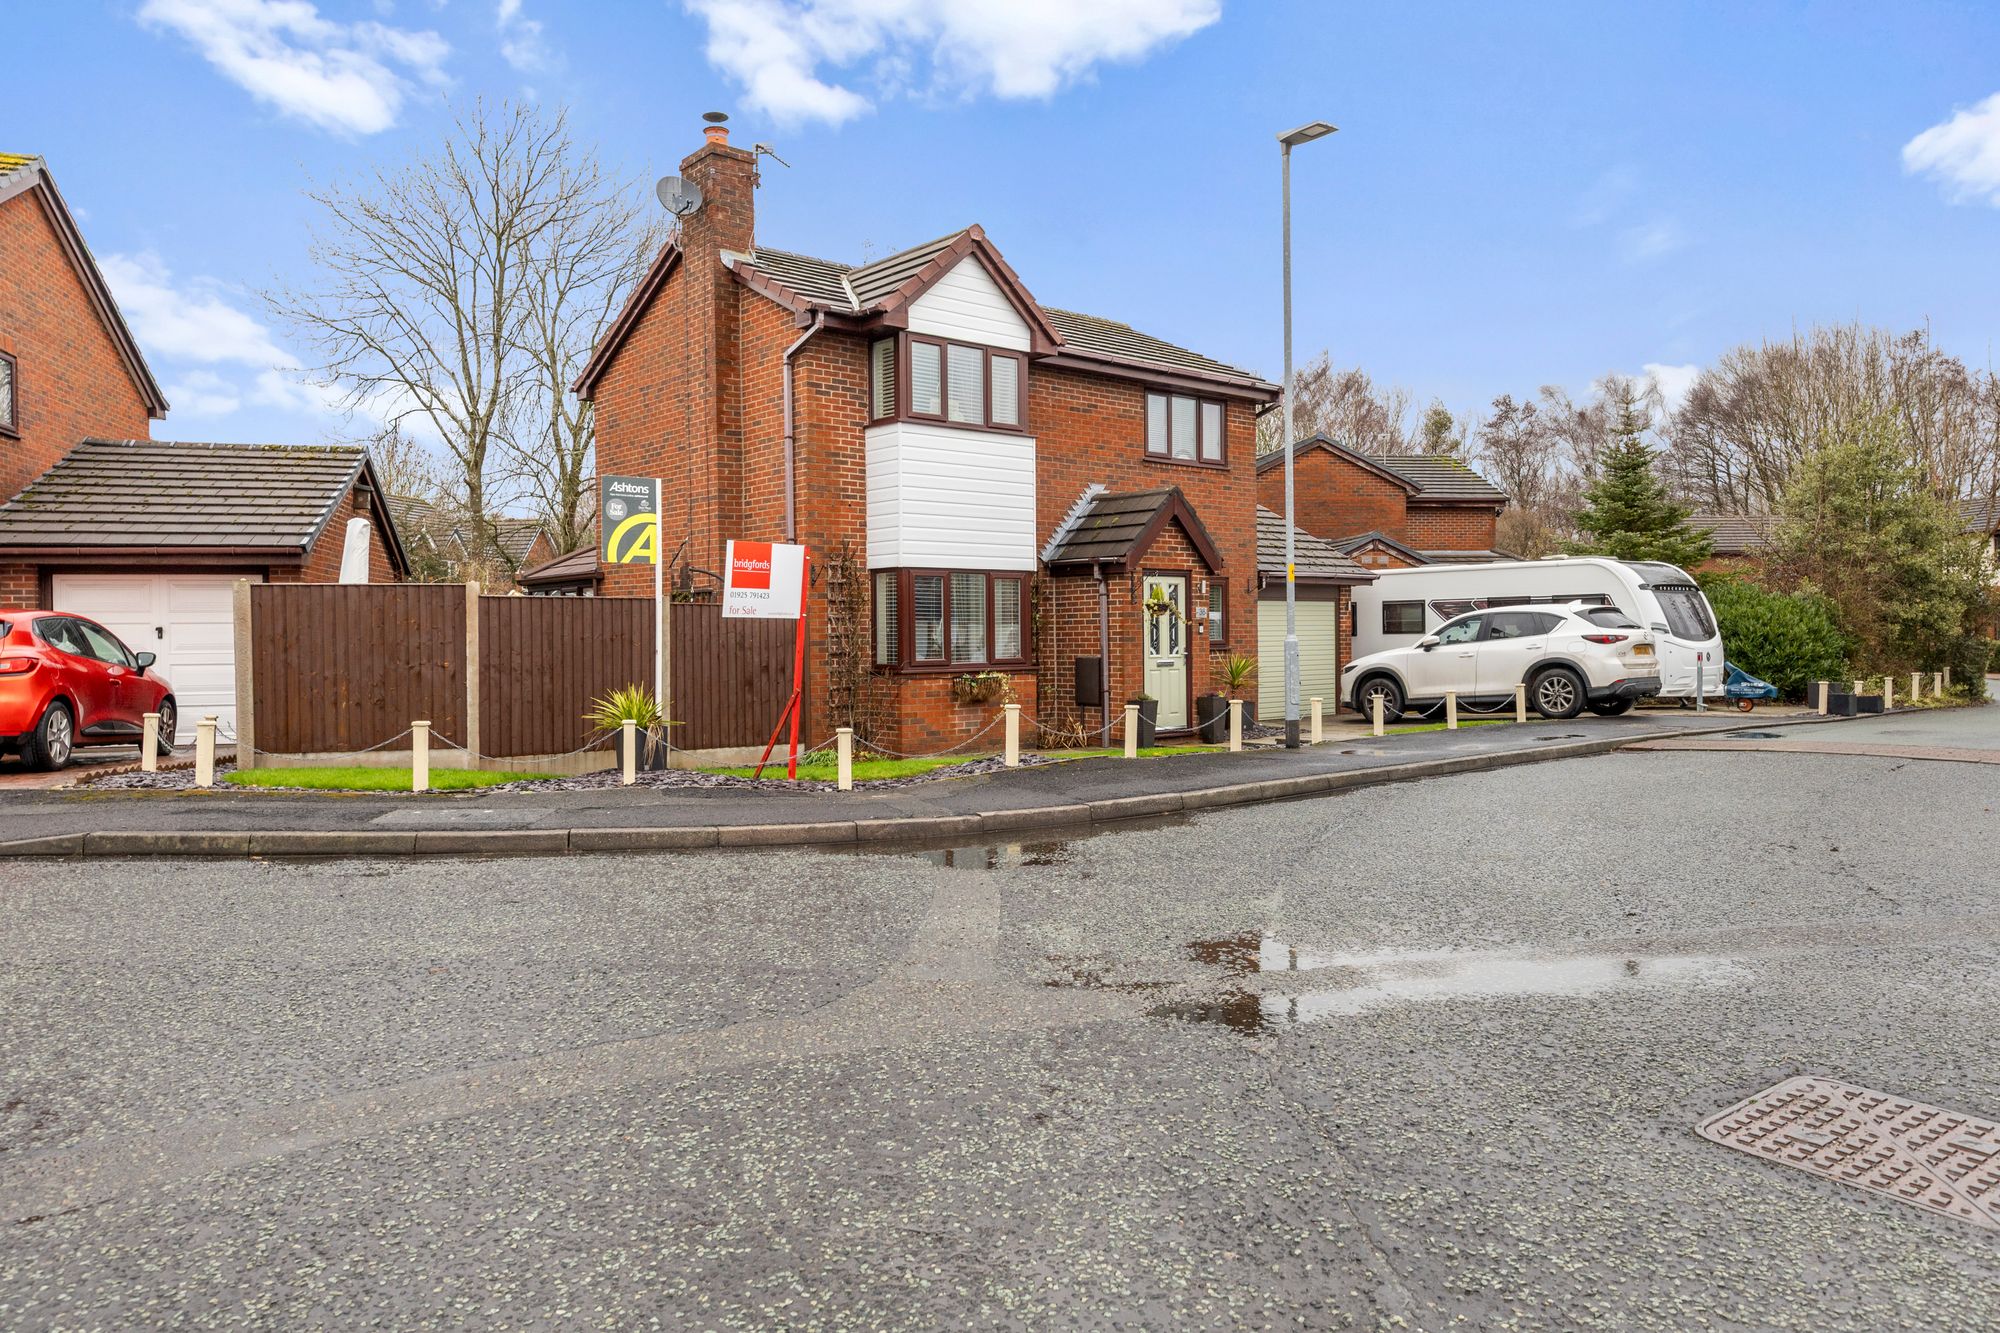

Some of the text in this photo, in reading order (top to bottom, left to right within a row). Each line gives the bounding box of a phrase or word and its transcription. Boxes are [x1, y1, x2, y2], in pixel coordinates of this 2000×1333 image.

[609, 481, 649, 494] Ashtons
[611, 502, 622, 510] For
[734, 558, 770, 571] bridgfords
[729, 591, 770, 600] 01925 791423
[729, 605, 740, 614] for
[742, 605, 757, 615] Sale
